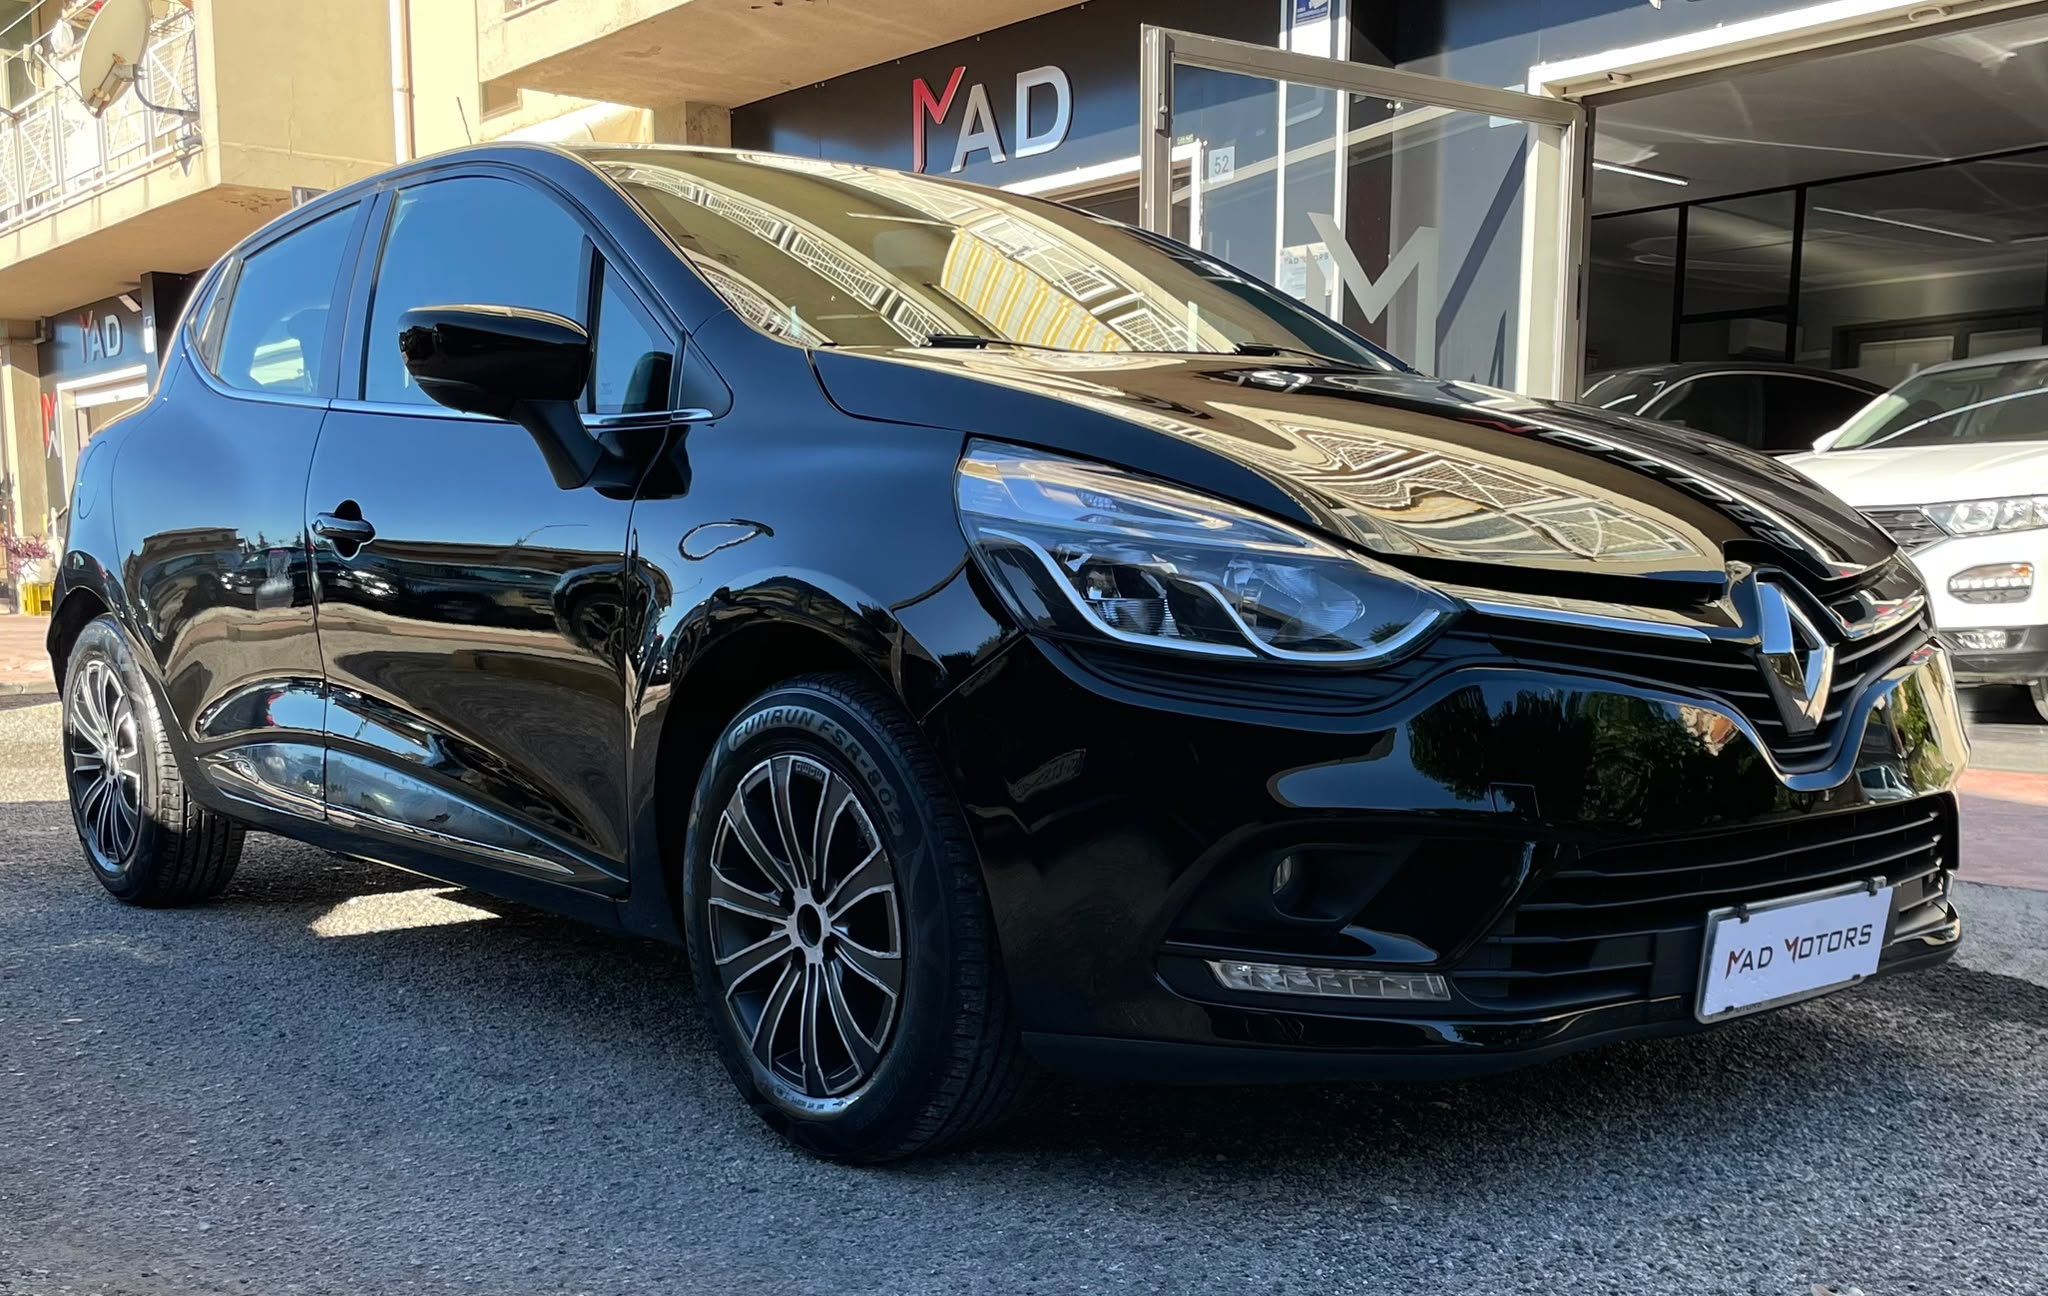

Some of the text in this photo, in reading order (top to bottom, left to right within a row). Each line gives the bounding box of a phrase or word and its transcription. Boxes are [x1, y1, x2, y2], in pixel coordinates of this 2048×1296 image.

[912, 65, 1073, 174] MAD
[1214, 155, 1230, 175] 52
[80, 309, 124, 364] MAD
[1725, 924, 1873, 980] MAD MOTORS
